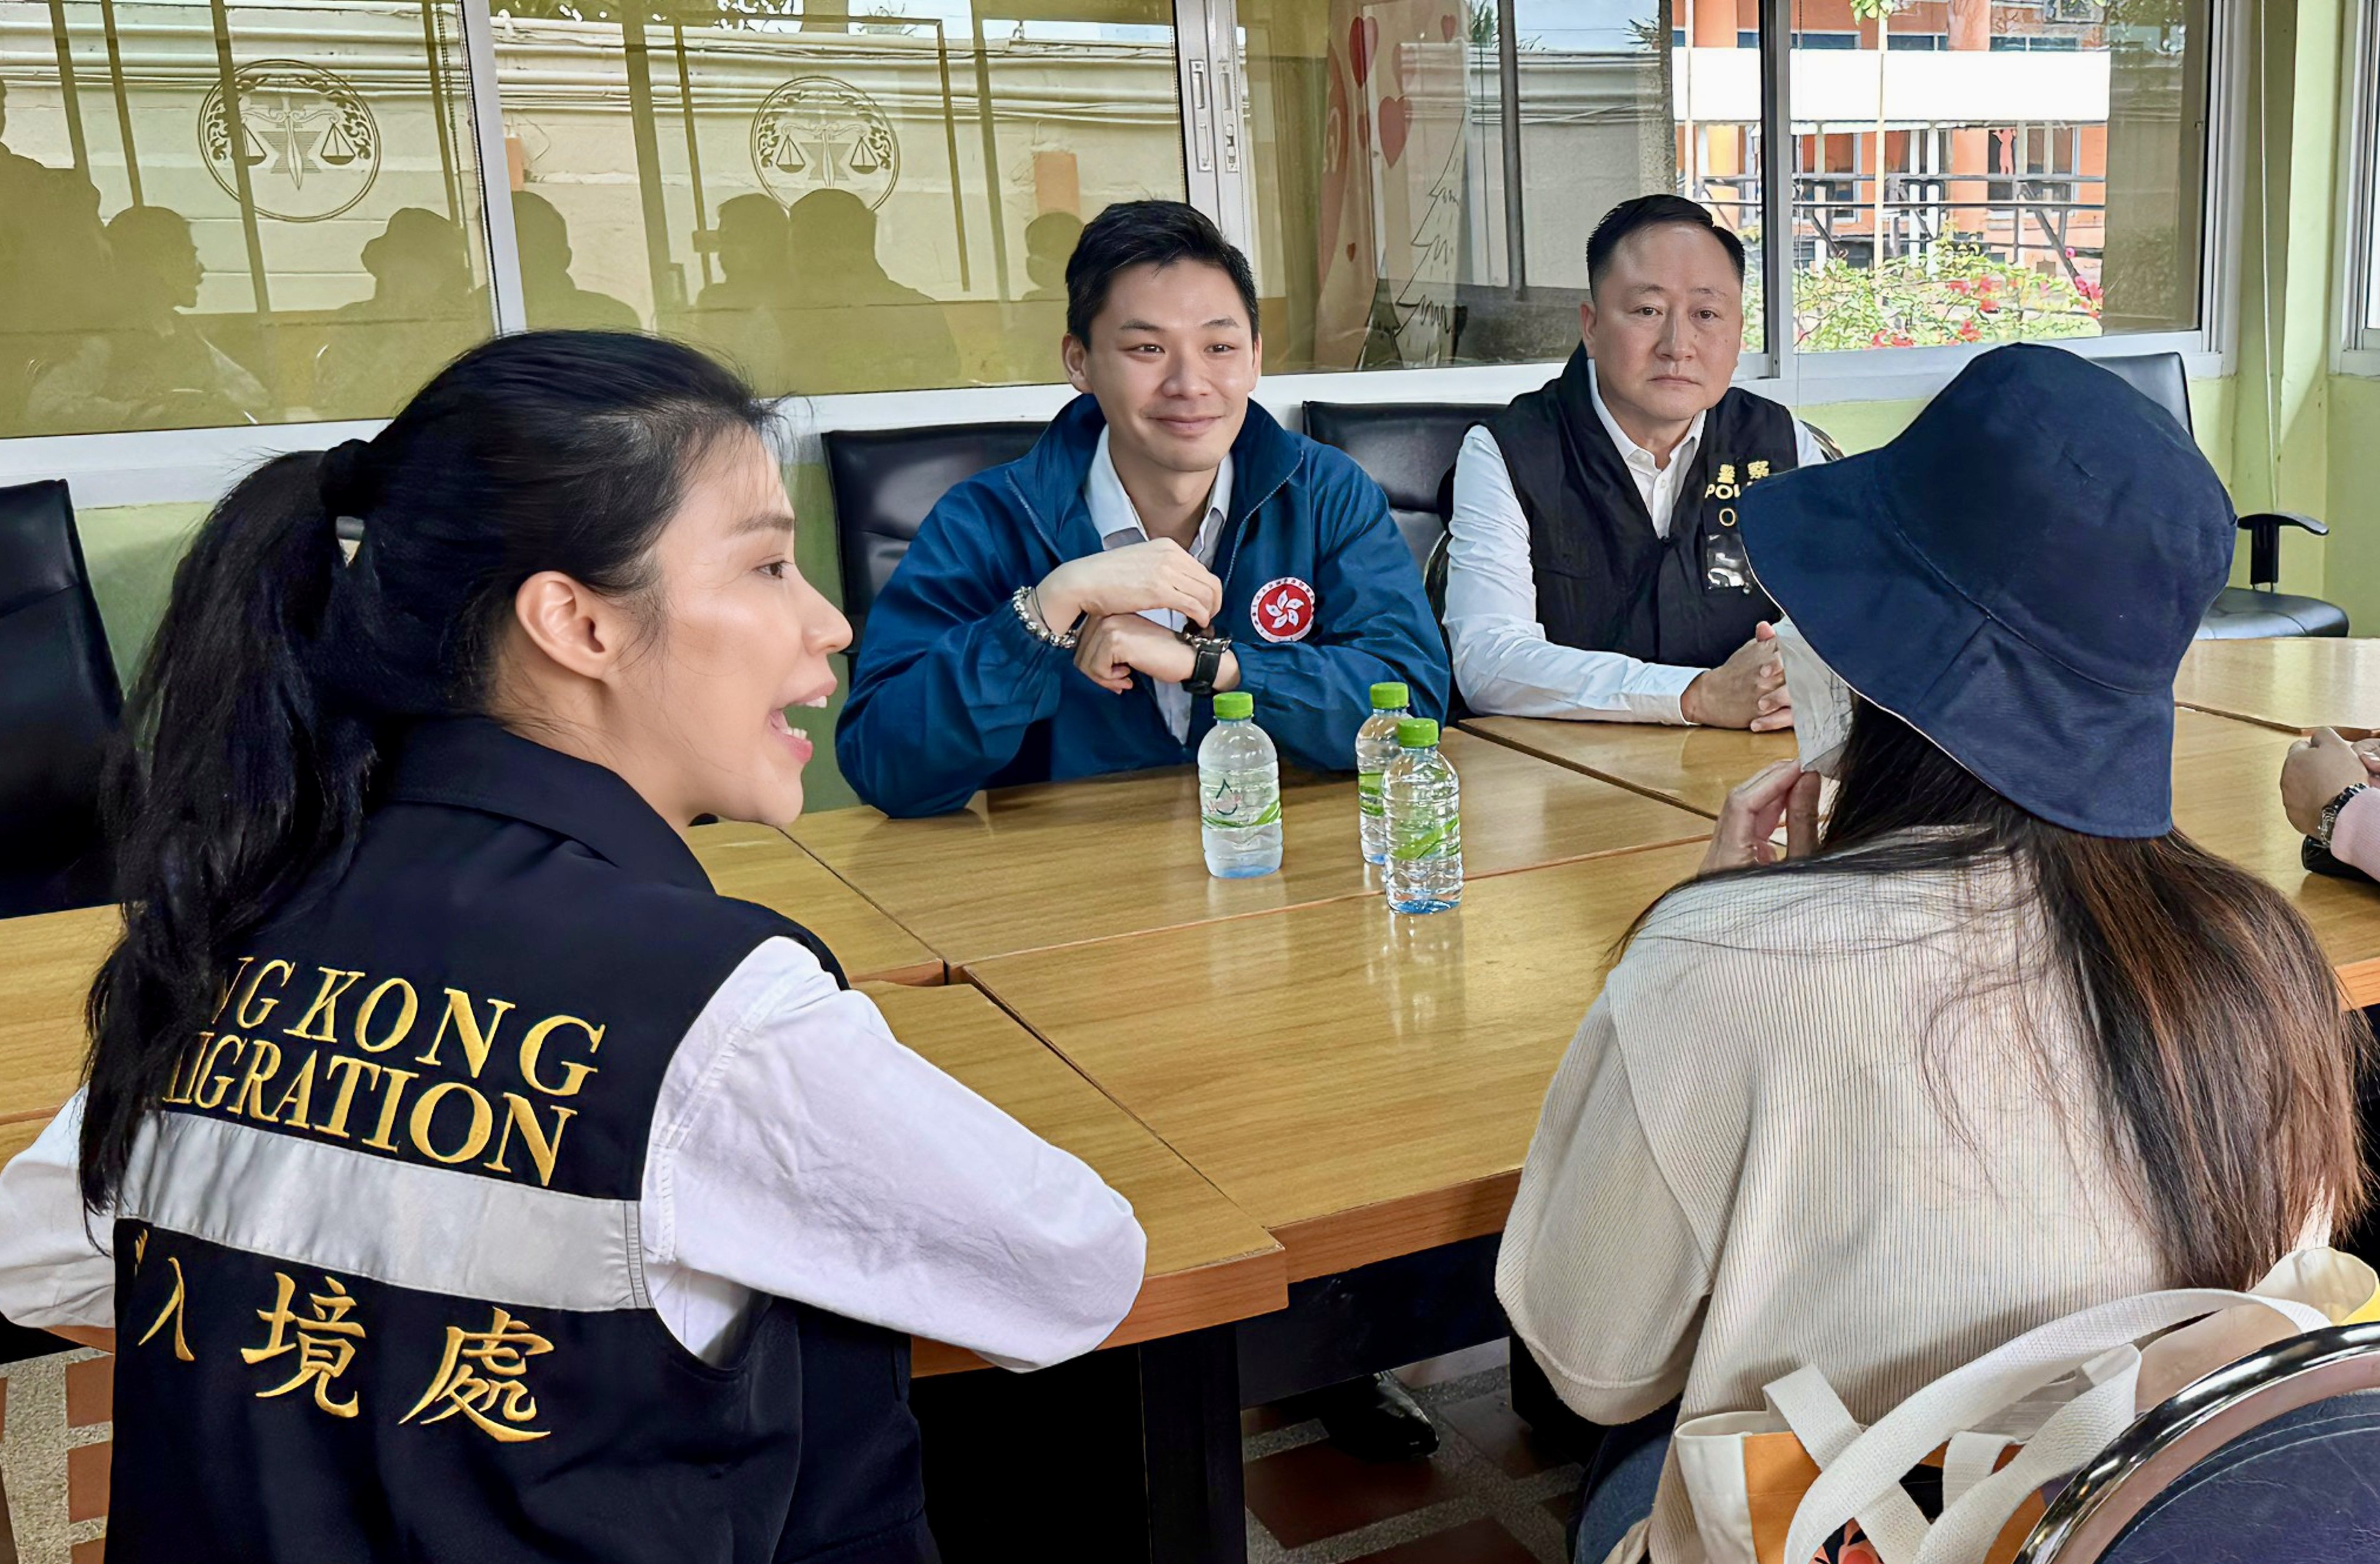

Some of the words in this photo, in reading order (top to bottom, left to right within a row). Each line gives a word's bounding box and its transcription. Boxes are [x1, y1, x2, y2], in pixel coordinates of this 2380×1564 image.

[162, 1031, 577, 1187] IGRATION
[283, 966, 606, 1097] KONG
[135, 1228, 554, 1442] 入境處
